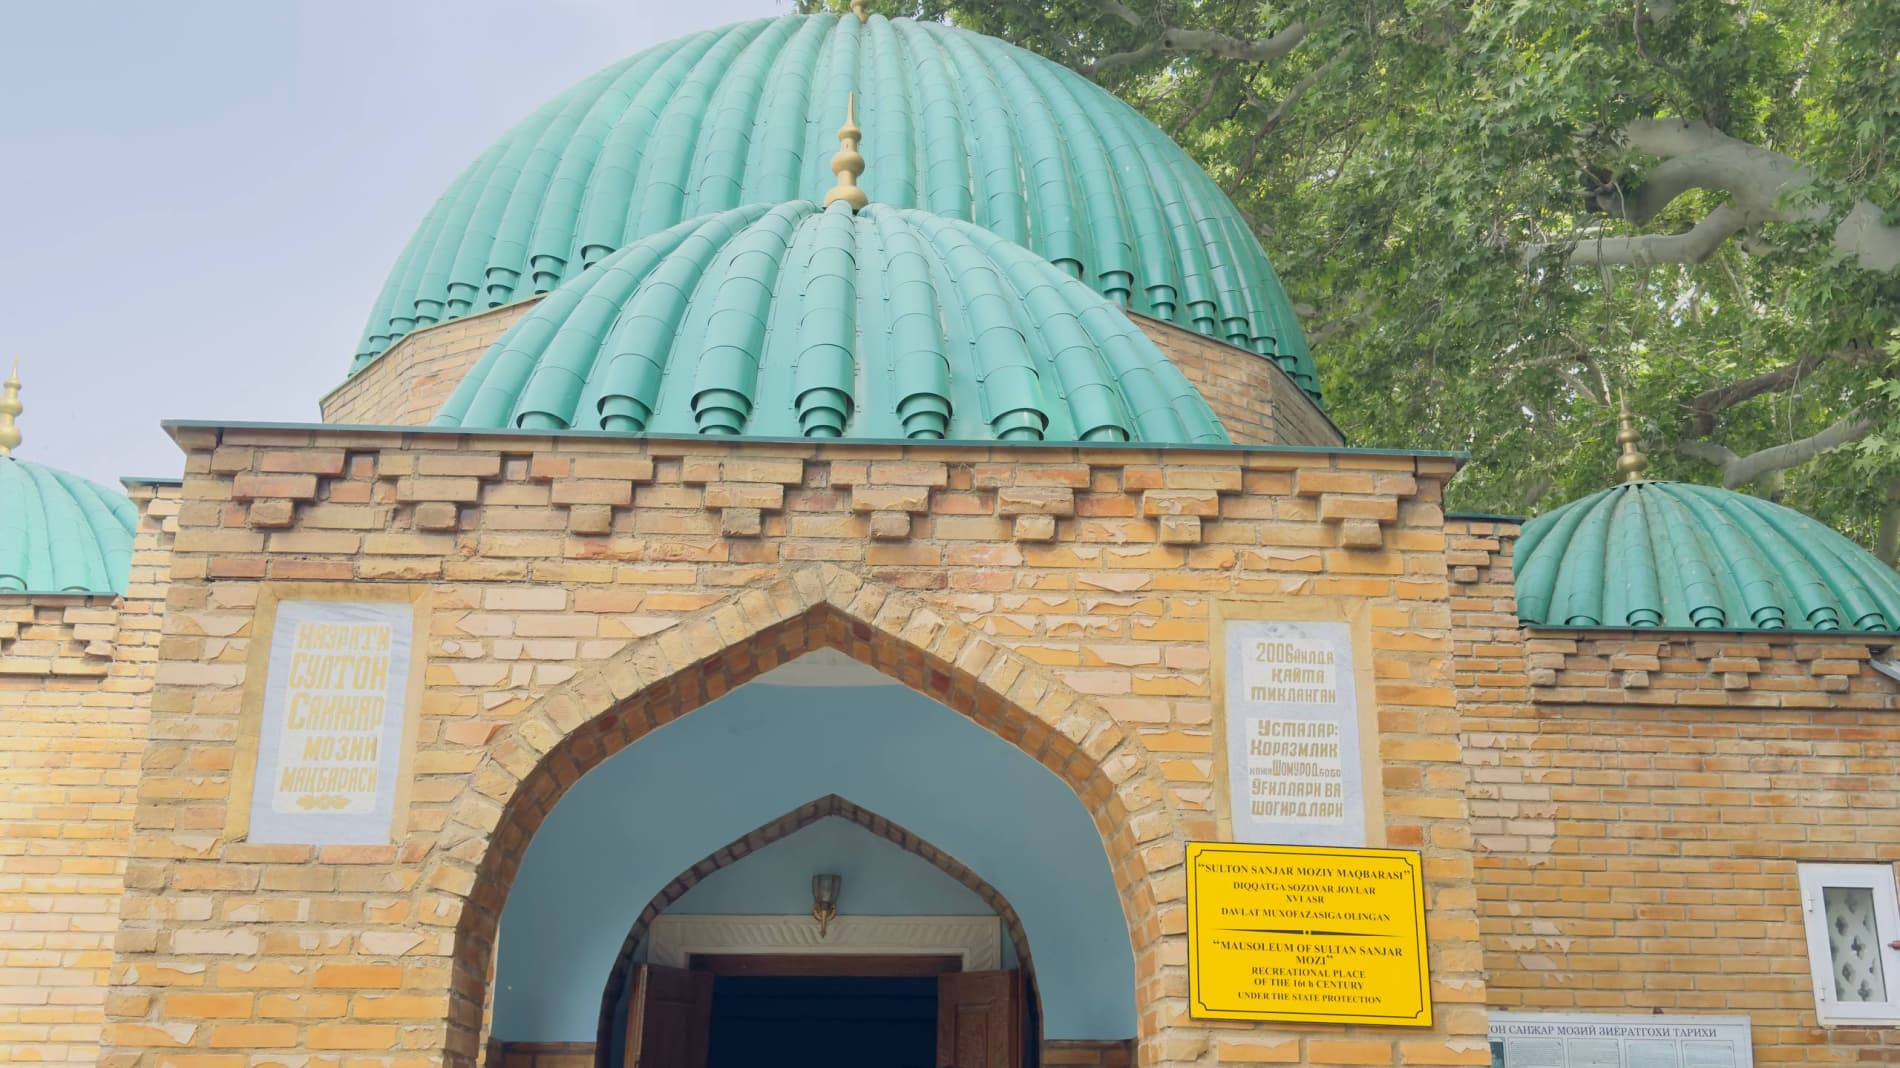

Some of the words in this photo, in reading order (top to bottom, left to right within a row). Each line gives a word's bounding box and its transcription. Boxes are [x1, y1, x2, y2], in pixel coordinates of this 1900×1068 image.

[1256, 642, 1293, 664] 2006
[1251, 865, 1294, 875] SANJAR
[1297, 867, 1333, 877] MOZIY
[1233, 881, 1286, 892] DIQQATGA
[1287, 884, 1334, 894] SOZOVAR
[1337, 885, 1376, 895] JOYLAR
[1286, 894, 1303, 903] XVI
[1306, 895, 1325, 904] ASR
[1221, 907, 1260, 917] DAVLAT
[1262, 908, 1342, 920] MUXOFAZASIGA
[1344, 912, 1391, 922] OLINGAN
[1296, 943, 1312, 953] OF
[1314, 944, 1357, 955] SULTAN
[1360, 946, 1403, 957] SANJAR
[1251, 966, 1330, 978] RECREATIONAL
[1333, 969, 1366, 979] PLACE
[1253, 977, 1267, 987] OF
[1271, 978, 1289, 988] THE
[1316, 980, 1363, 990] CENTURY
[1238, 991, 1269, 1001] UNDER
[1272, 992, 1289, 1002] THE
[1291, 994, 1320, 1002] STATE
[1322, 994, 1382, 1005] PROTECTION
